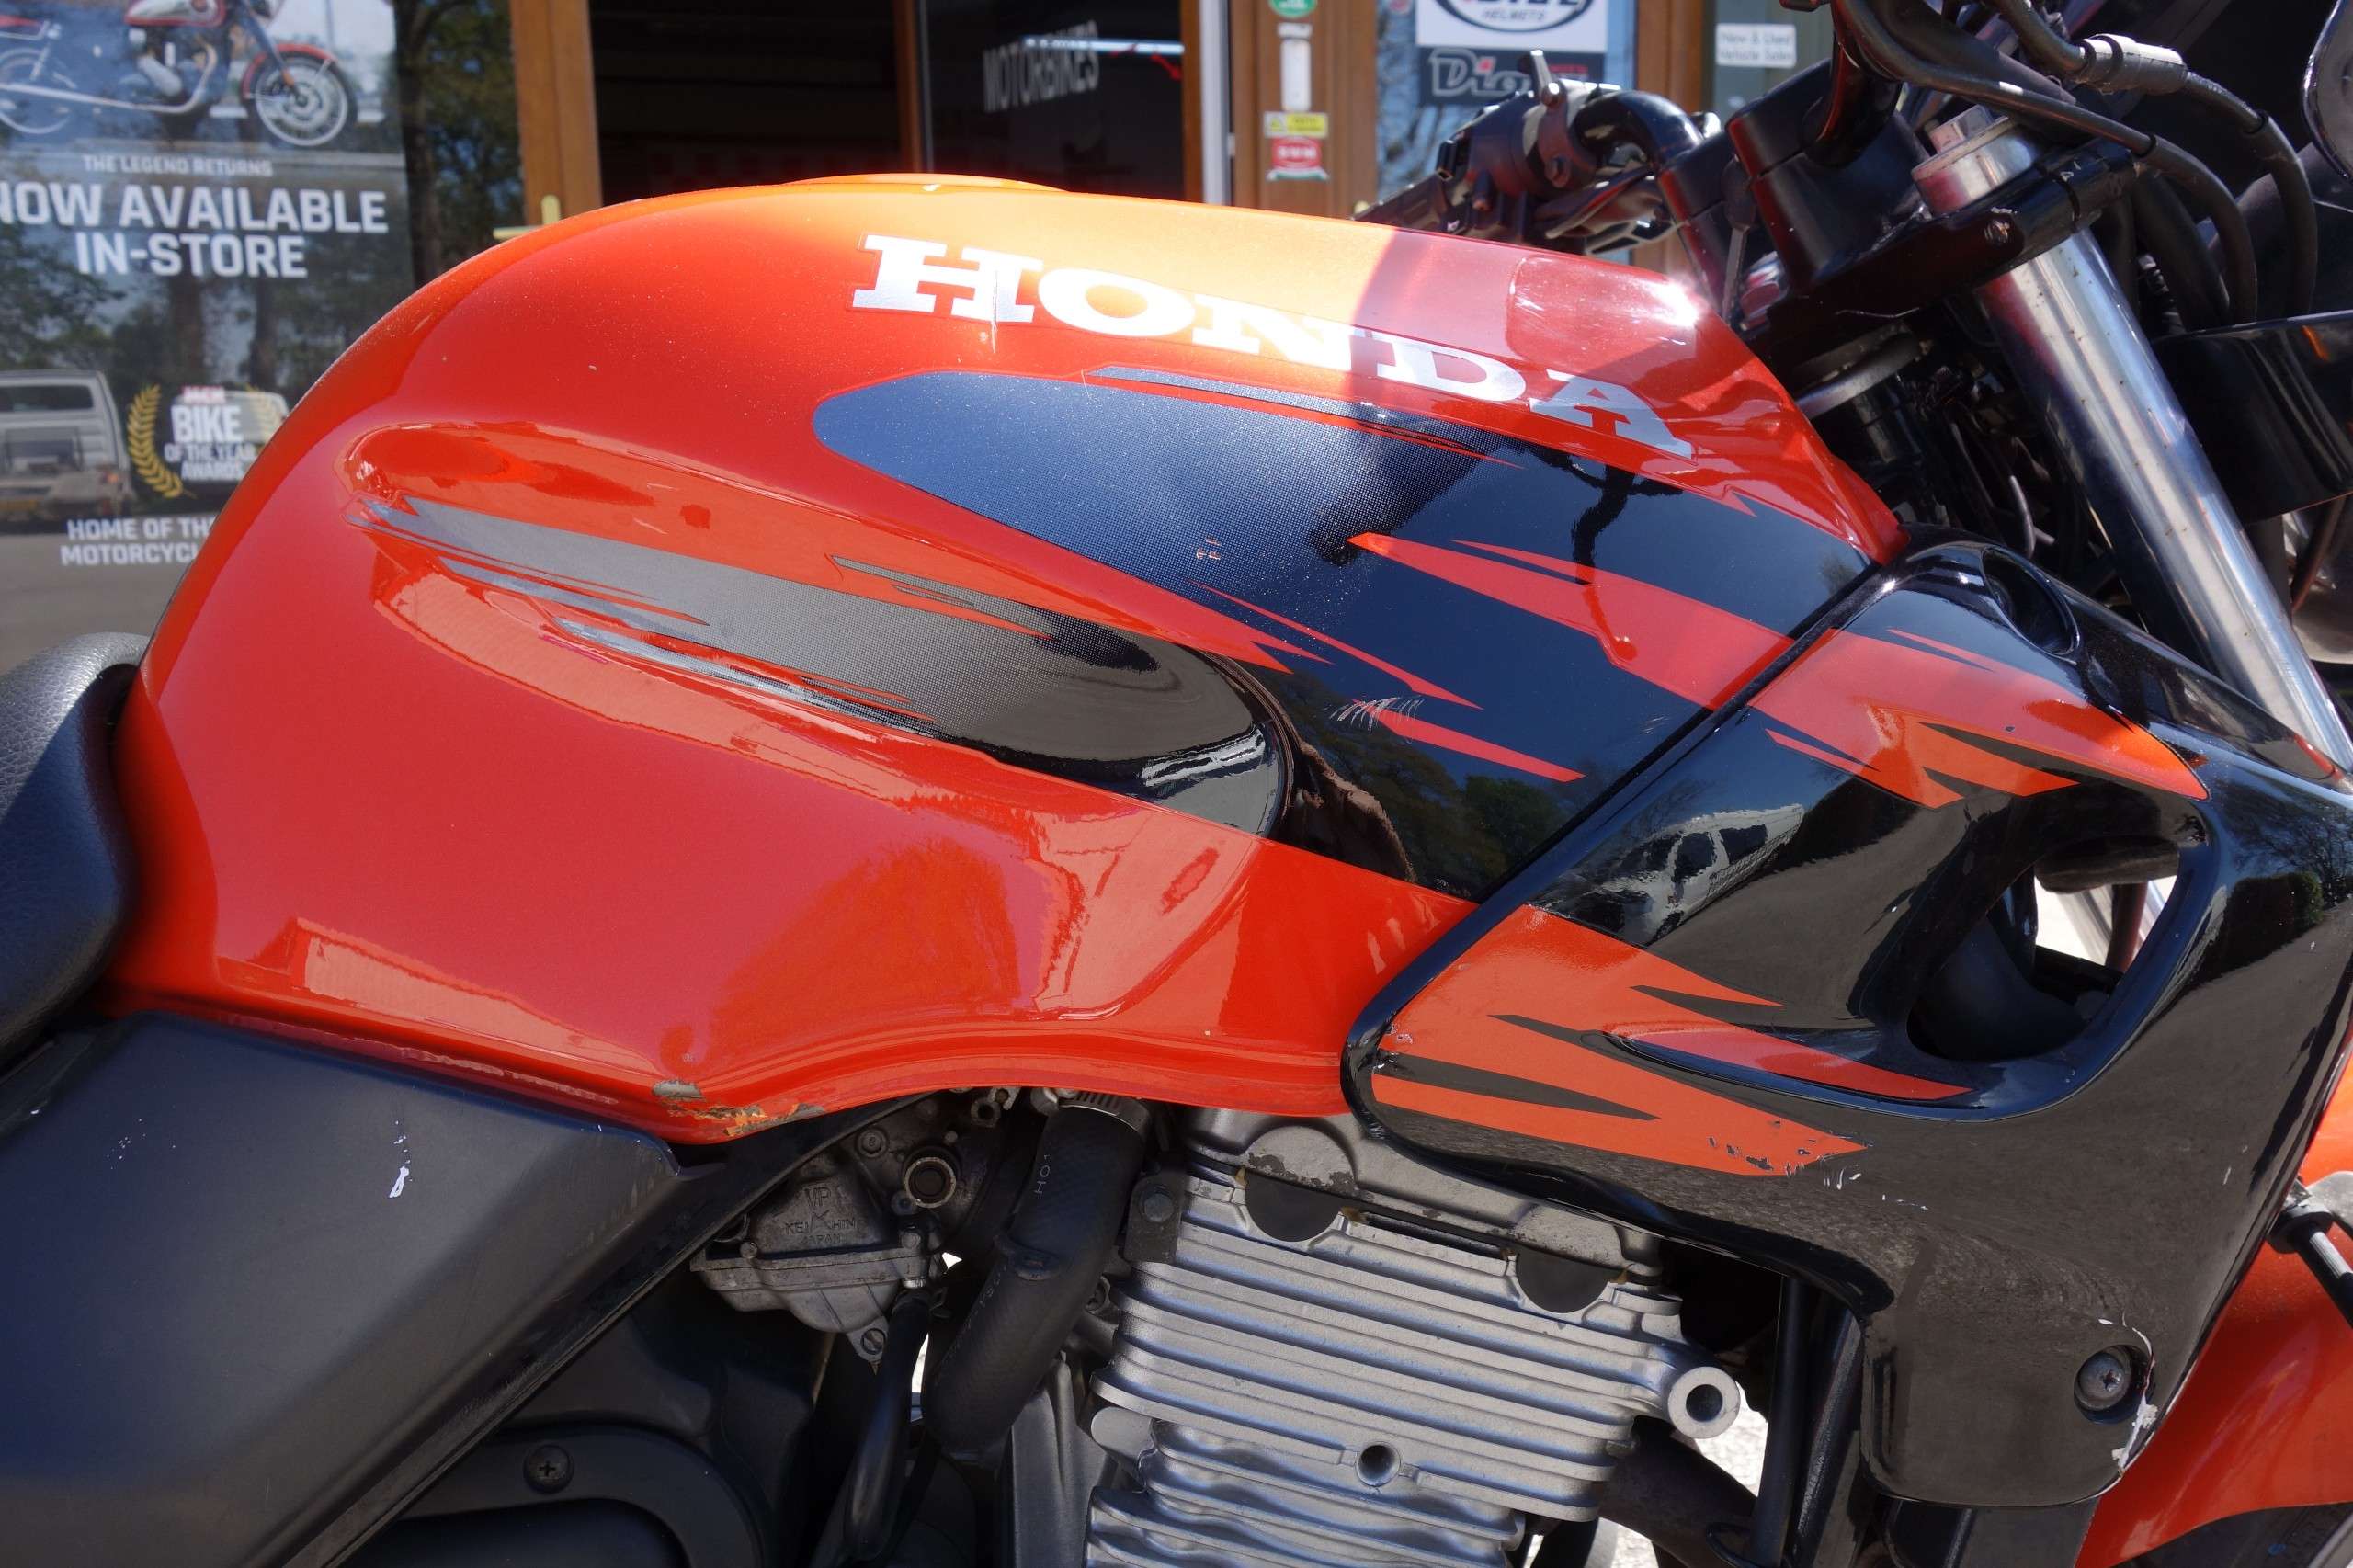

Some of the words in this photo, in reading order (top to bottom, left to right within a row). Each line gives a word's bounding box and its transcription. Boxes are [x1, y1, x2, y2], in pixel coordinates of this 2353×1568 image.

[983, 19, 1100, 113] MOTORBIKES
[83, 154, 115, 174] THE
[121, 155, 187, 175] LEGEND
[193, 156, 273, 177] RETURNS
[119, 185, 390, 233] AVAILABLE
[75, 231, 308, 278] IN-STORE
[853, 234, 1695, 460] HONDA
[171, 404, 244, 443] BIKE
[164, 443, 184, 462] OF
[66, 517, 138, 541] HOME
[142, 517, 174, 540] OF
